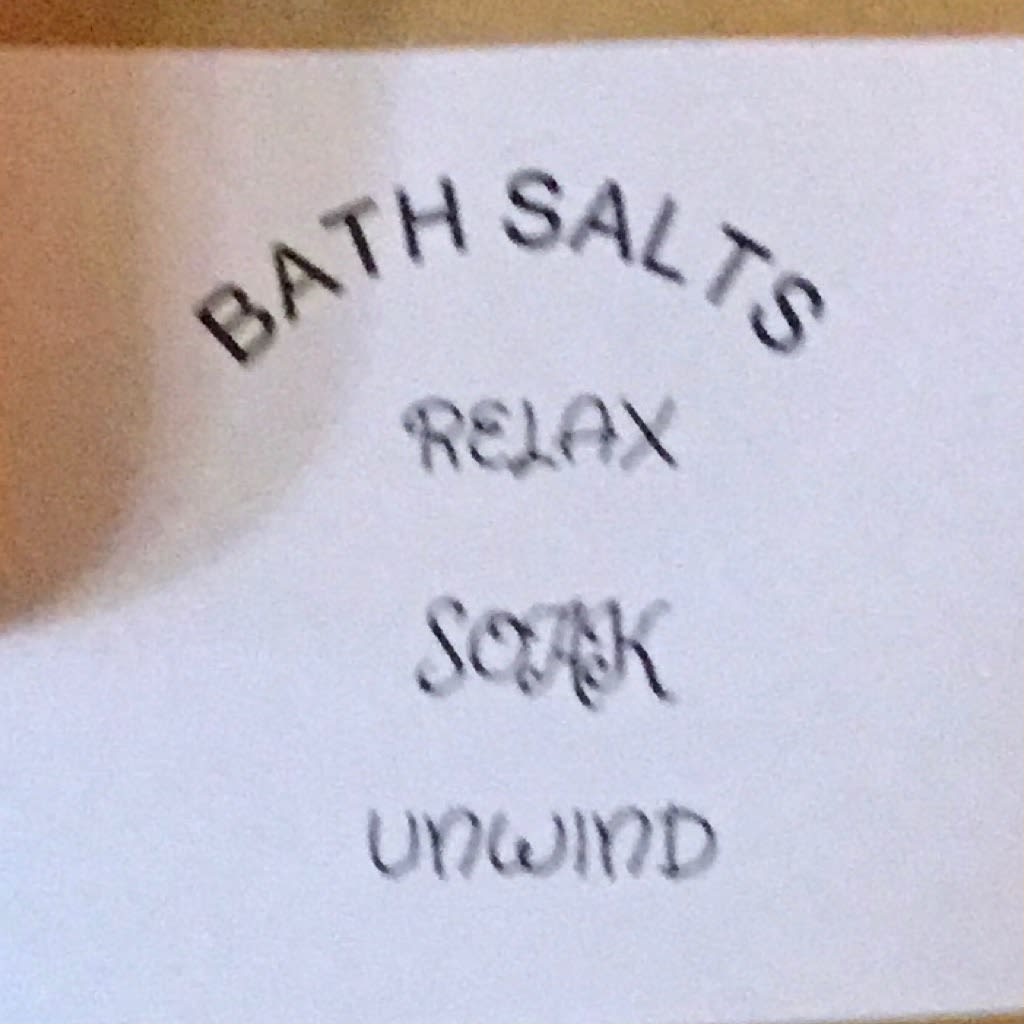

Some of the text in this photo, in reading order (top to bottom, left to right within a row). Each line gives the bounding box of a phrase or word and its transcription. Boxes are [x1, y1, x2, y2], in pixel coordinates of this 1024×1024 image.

[194, 167, 827, 368] BATH SALTS
[402, 394, 679, 478] RELAX
[413, 595, 674, 710] SOAK
